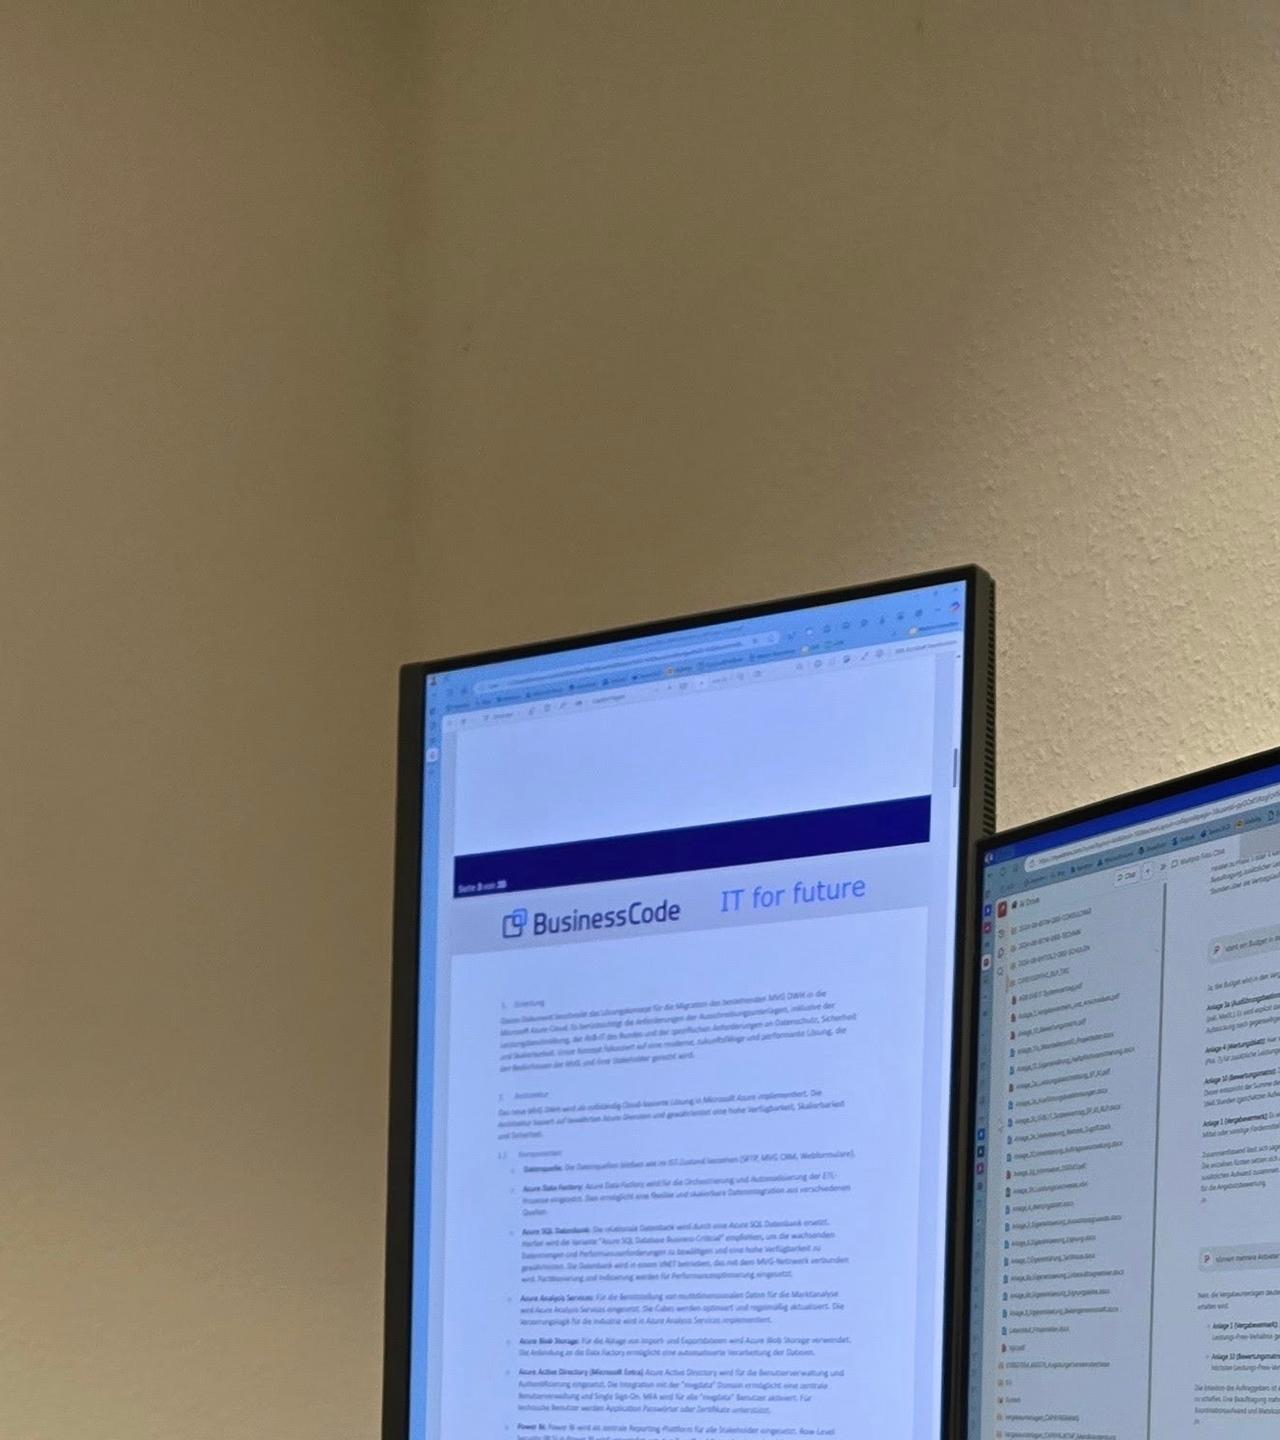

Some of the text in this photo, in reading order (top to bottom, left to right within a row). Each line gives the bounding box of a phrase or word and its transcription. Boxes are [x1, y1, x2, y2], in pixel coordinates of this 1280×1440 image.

[720, 876, 866, 913] IT for future
[533, 900, 681, 936] BusinessCode
